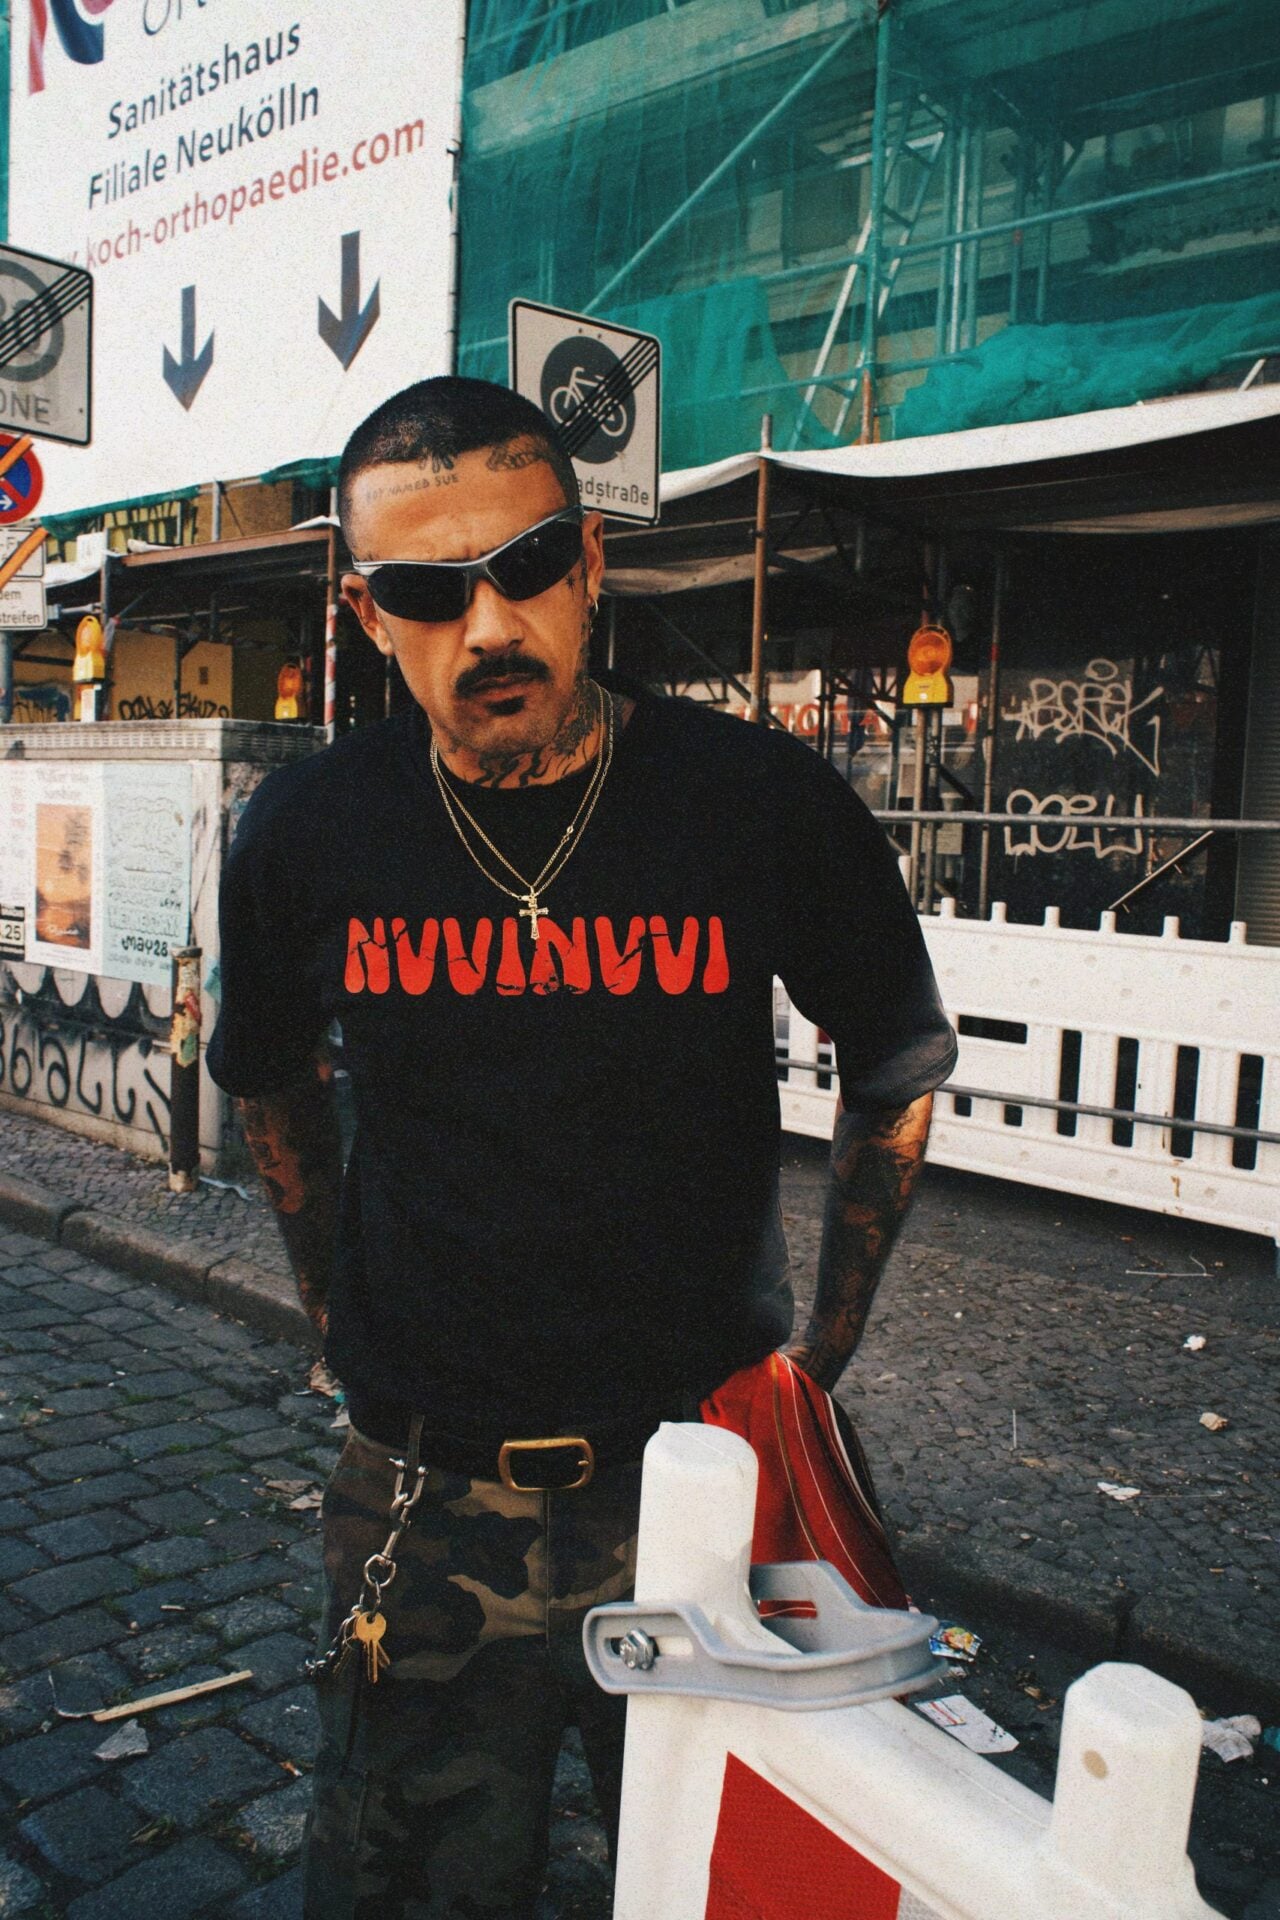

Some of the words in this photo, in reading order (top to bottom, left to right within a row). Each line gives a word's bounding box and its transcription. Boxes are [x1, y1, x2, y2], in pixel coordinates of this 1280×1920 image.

[108, 23, 300, 139] Sanitätshaus
[88, 149, 166, 210] Filiale
[176, 85, 319, 174] Neukölln
